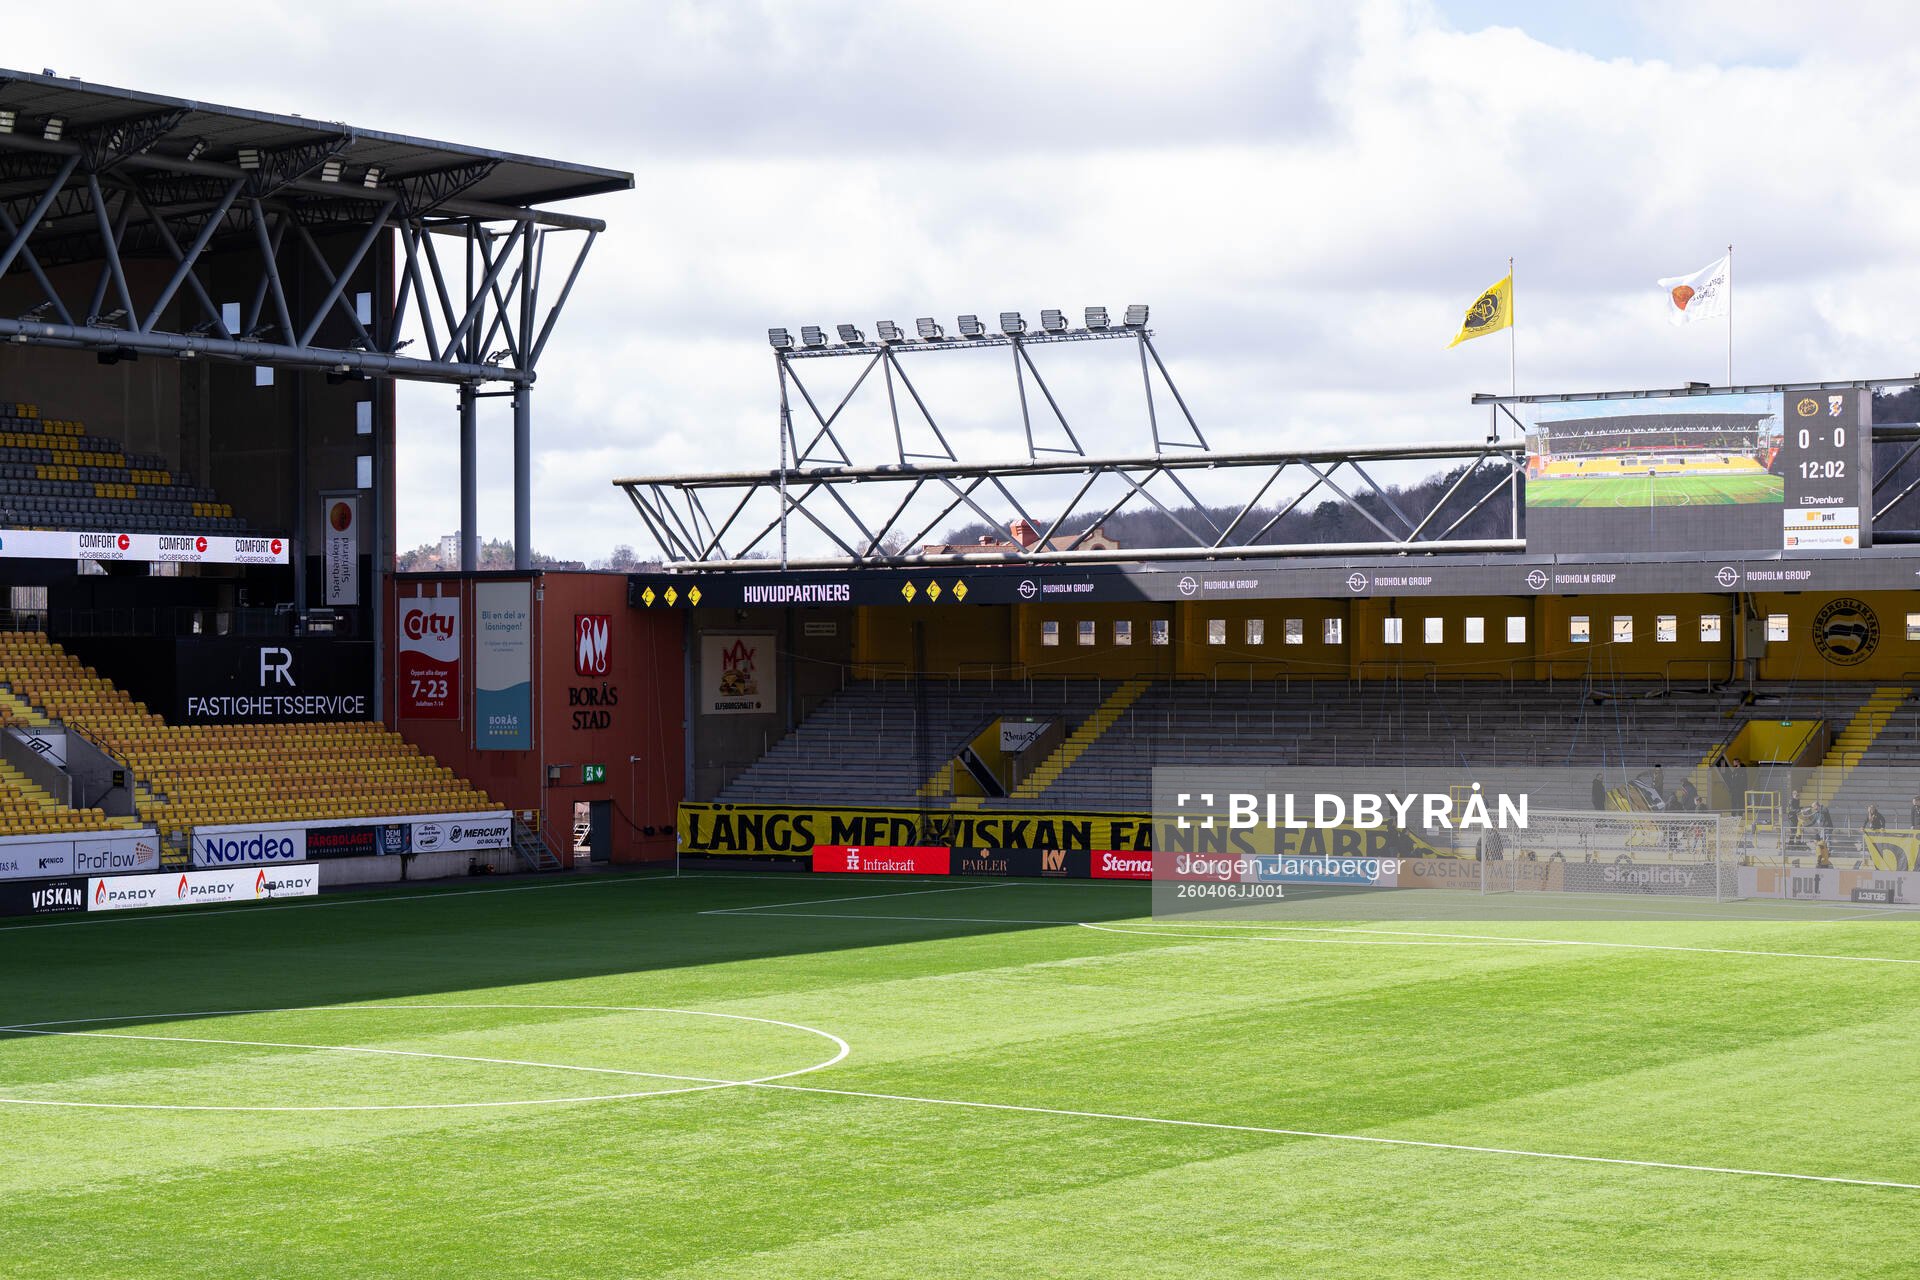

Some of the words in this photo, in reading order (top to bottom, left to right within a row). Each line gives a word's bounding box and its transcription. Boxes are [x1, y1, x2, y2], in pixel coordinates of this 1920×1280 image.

[1799, 429, 1810, 449] 0
[1834, 428, 1845, 448] 0
[1799, 460, 1845, 479] 12:02
[79, 534, 117, 548] COMFORT
[159, 536, 194, 550] COMFORT
[235, 539, 269, 553] COMFORT
[331, 537, 341, 600] Sparbanken
[1747, 571, 1784, 581] RUDHOLM
[1785, 570, 1811, 580] GROUP
[1204, 581, 1235, 590] RUDHOLM
[1236, 580, 1258, 589] GROUP
[1374, 577, 1407, 586] RUDHOLM
[1408, 576, 1432, 586] GROUP
[1555, 574, 1590, 584] RUDHOLM
[1591, 574, 1616, 583] GROUP
[744, 584, 850, 603] HUVUDPARTNERS
[1042, 584, 1072, 594] RUDHOLM
[1074, 583, 1094, 593] GROUP
[482, 610, 490, 619] Bli
[503, 610, 516, 619] del
[404, 609, 455, 640] City
[485, 621, 522, 632] lösningen!
[723, 640, 756, 670] MAX
[260, 647, 296, 687] FR
[411, 679, 448, 698] 7-23
[569, 682, 618, 706] BORÅS
[188, 696, 365, 716] FASTIGHETSSERVICE
[489, 714, 518, 725] BORÅS
[572, 710, 611, 730] STAD
[464, 828, 509, 838] MERCURY
[689, 803, 815, 852] LÄNGS
[206, 833, 294, 863] Nordea
[39, 857, 64, 869] KANICO
[78, 851, 135, 869] ProFlow
[864, 859, 915, 871] Infrakraft
[962, 859, 1007, 871] PARLER
[1413, 861, 1482, 878] GÄSENE
[109, 889, 156, 901] PAROY
[190, 883, 235, 895] PAROY
[32, 888, 82, 908] VISKAN
[1858, 892, 1887, 901] SELECT
